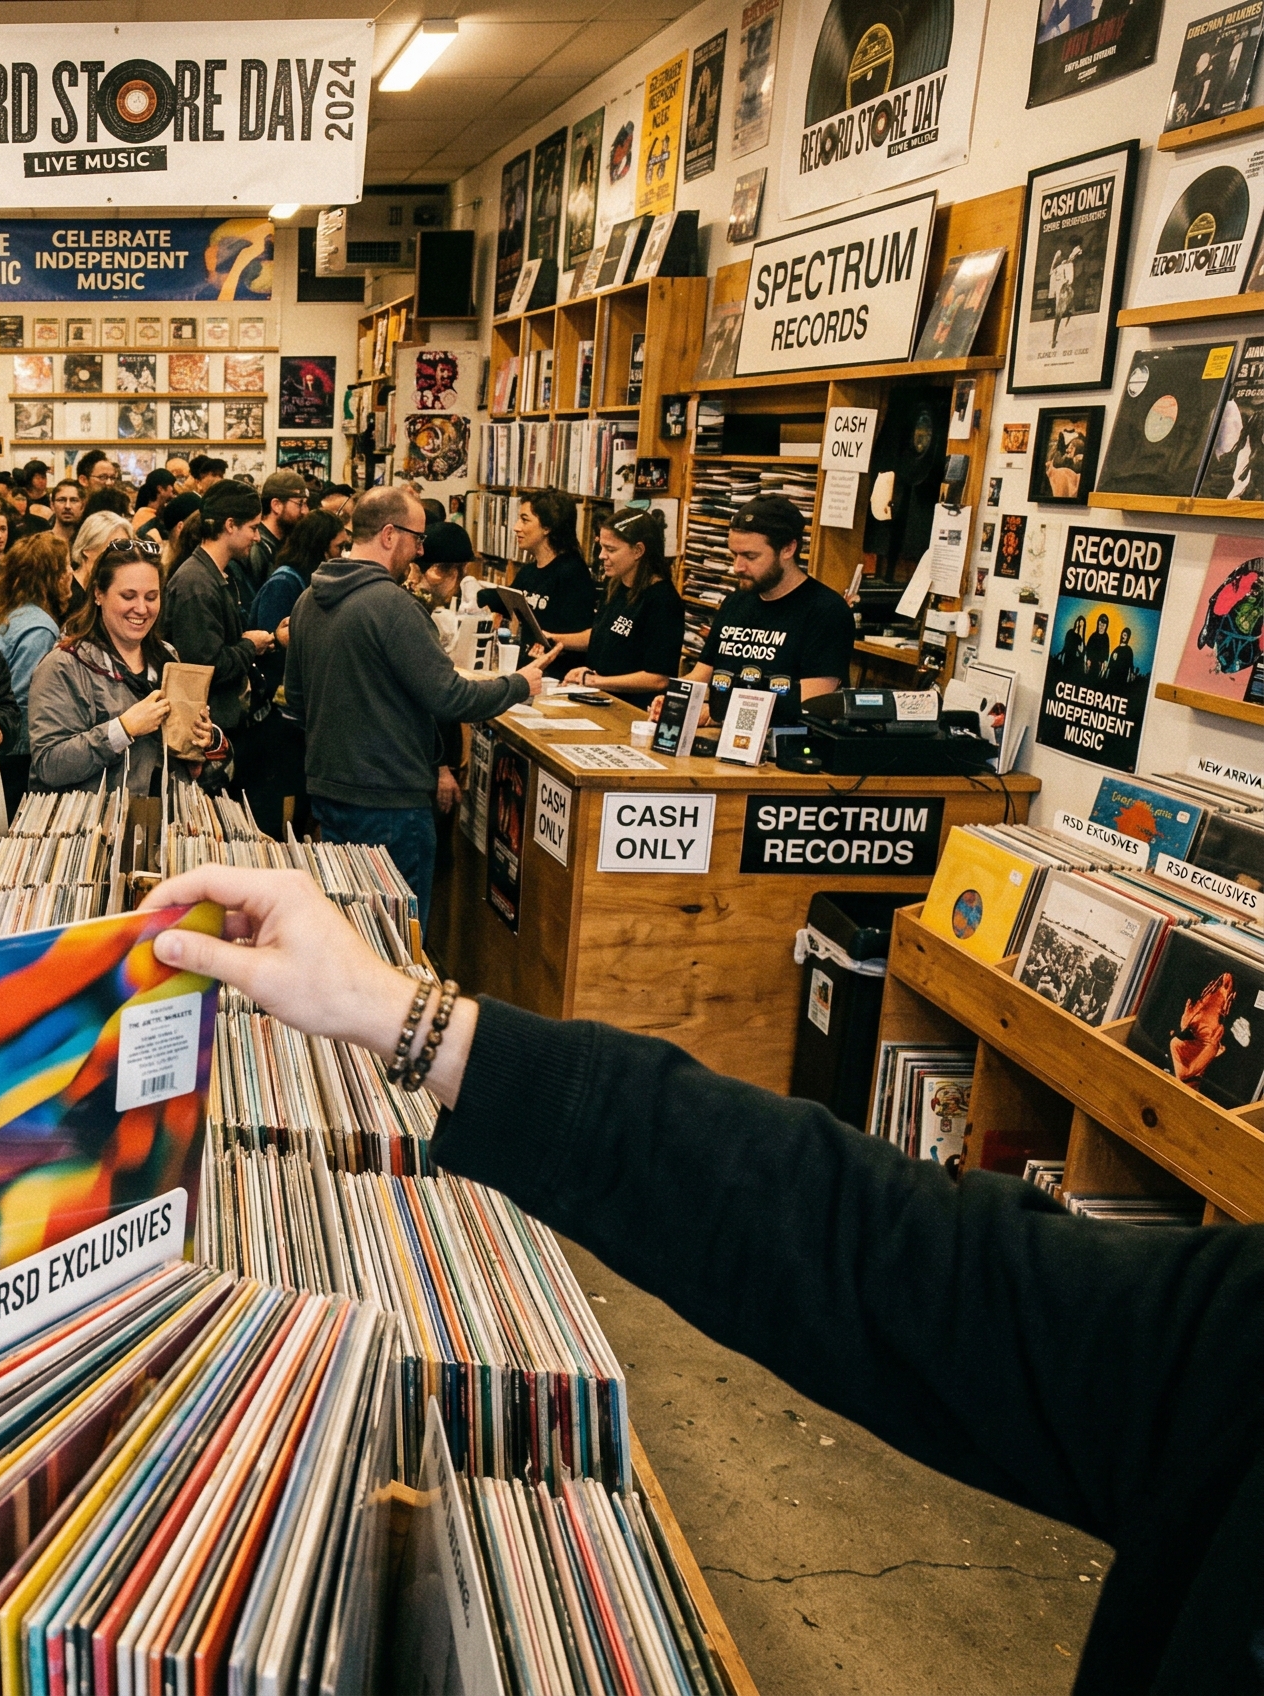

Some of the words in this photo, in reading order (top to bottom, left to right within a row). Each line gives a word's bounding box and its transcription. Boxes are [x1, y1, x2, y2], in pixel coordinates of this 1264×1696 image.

[52, 58, 227, 144] STORE
[238, 58, 324, 141] DAY
[324, 57, 356, 141] 2024
[799, 114, 854, 175] RECORD
[856, 90, 911, 155] STORE
[912, 74, 947, 134] DAY
[34, 155, 77, 173] LIVE
[85, 151, 150, 170] MUSIC
[1042, 191, 1076, 220] CASH
[1077, 181, 1113, 211] ONLY
[52, 230, 171, 248] CELEBRATE
[36, 251, 189, 269] INDEPENDENT
[754, 227, 918, 310] SPECTRUM
[1219, 243, 1242, 267] DAY
[77, 272, 145, 290] MUSIC
[771, 304, 869, 351] RECORDS
[834, 415, 868, 433] CASH
[831, 441, 863, 458] ONLY
[1071, 534, 1162, 571] RECORD
[1064, 566, 1120, 595] STORE
[1122, 573, 1162, 601] DAY
[719, 625, 787, 646] SPECTRUM
[1055, 681, 1128, 715] CELEBRATE
[1045, 698, 1135, 738] INDEPENDENT
[1064, 724, 1105, 751] MUSIC
[1197, 757, 1223, 775] NEW
[1223, 767, 1264, 789] ARRIVA
[540, 782, 567, 818] CASH
[538, 812, 565, 850] ONLY
[615, 804, 699, 829] CASH
[756, 805, 929, 833] SPECTRUM
[1062, 814, 1084, 831] RSD
[614, 837, 696, 861] ONLY
[763, 839, 915, 866] RECORDS
[1166, 860, 1188, 879] RSD
[1190, 873, 1258, 909] EXCLUSIVES
[48, 1202, 173, 1294] EXCLUSIVES
